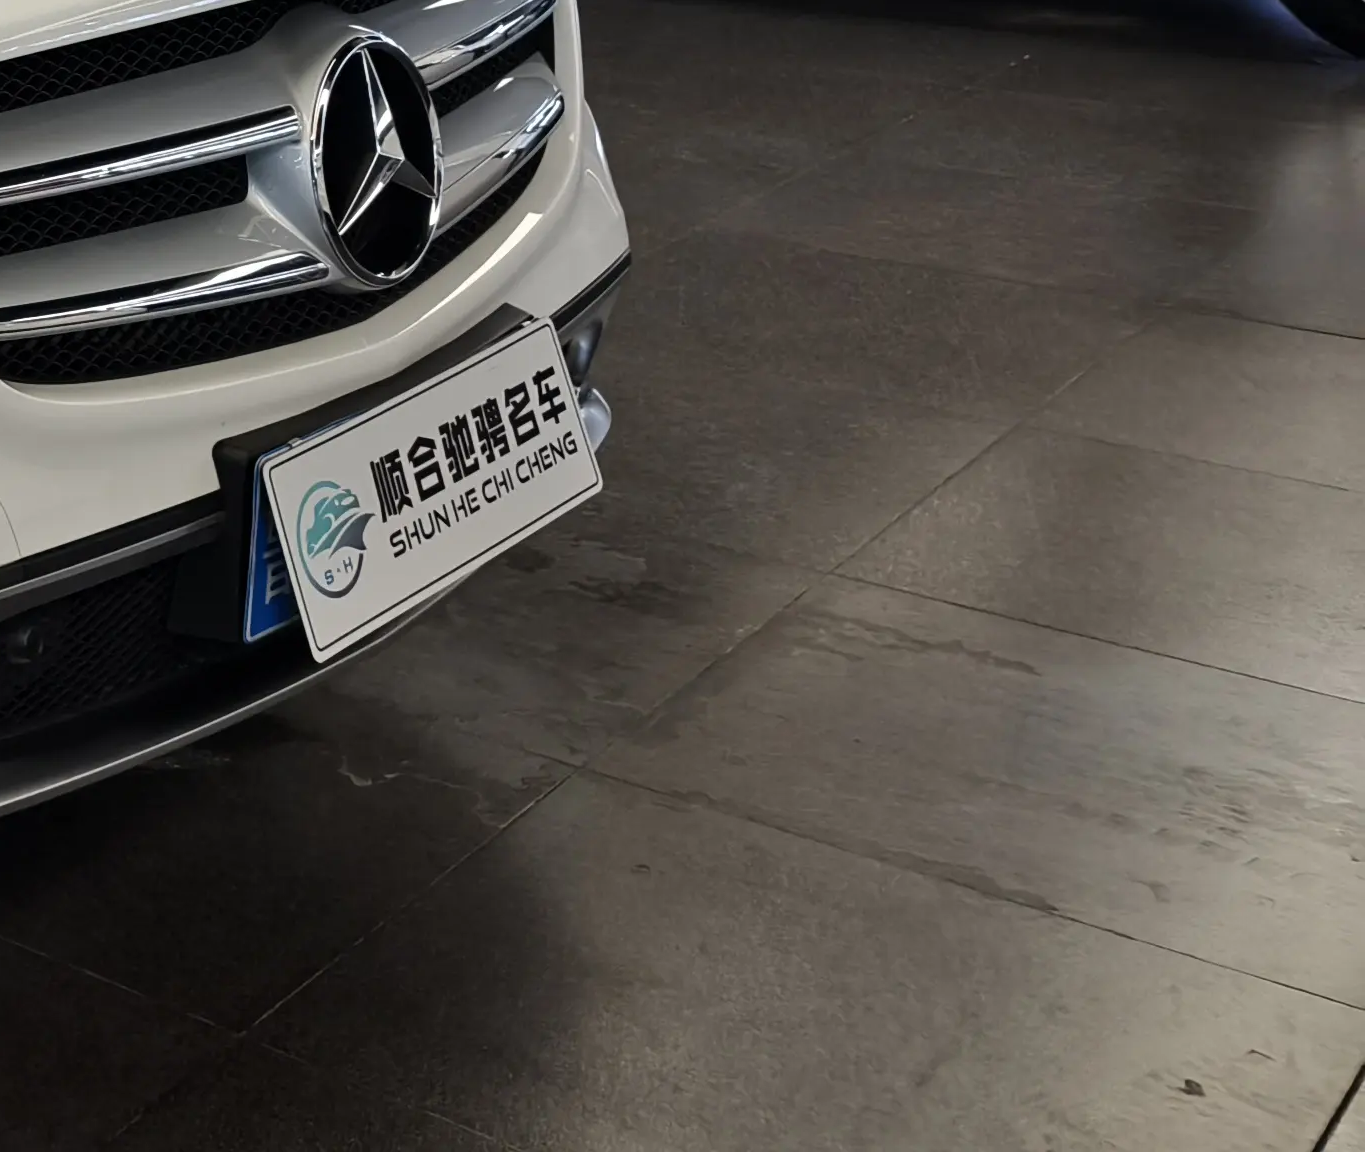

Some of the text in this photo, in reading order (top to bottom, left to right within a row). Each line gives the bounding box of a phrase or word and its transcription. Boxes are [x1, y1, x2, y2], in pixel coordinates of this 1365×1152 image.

[370, 366, 567, 523] 顺合驰骋名车
[389, 431, 579, 558] SHUN HE CHI CHENG
